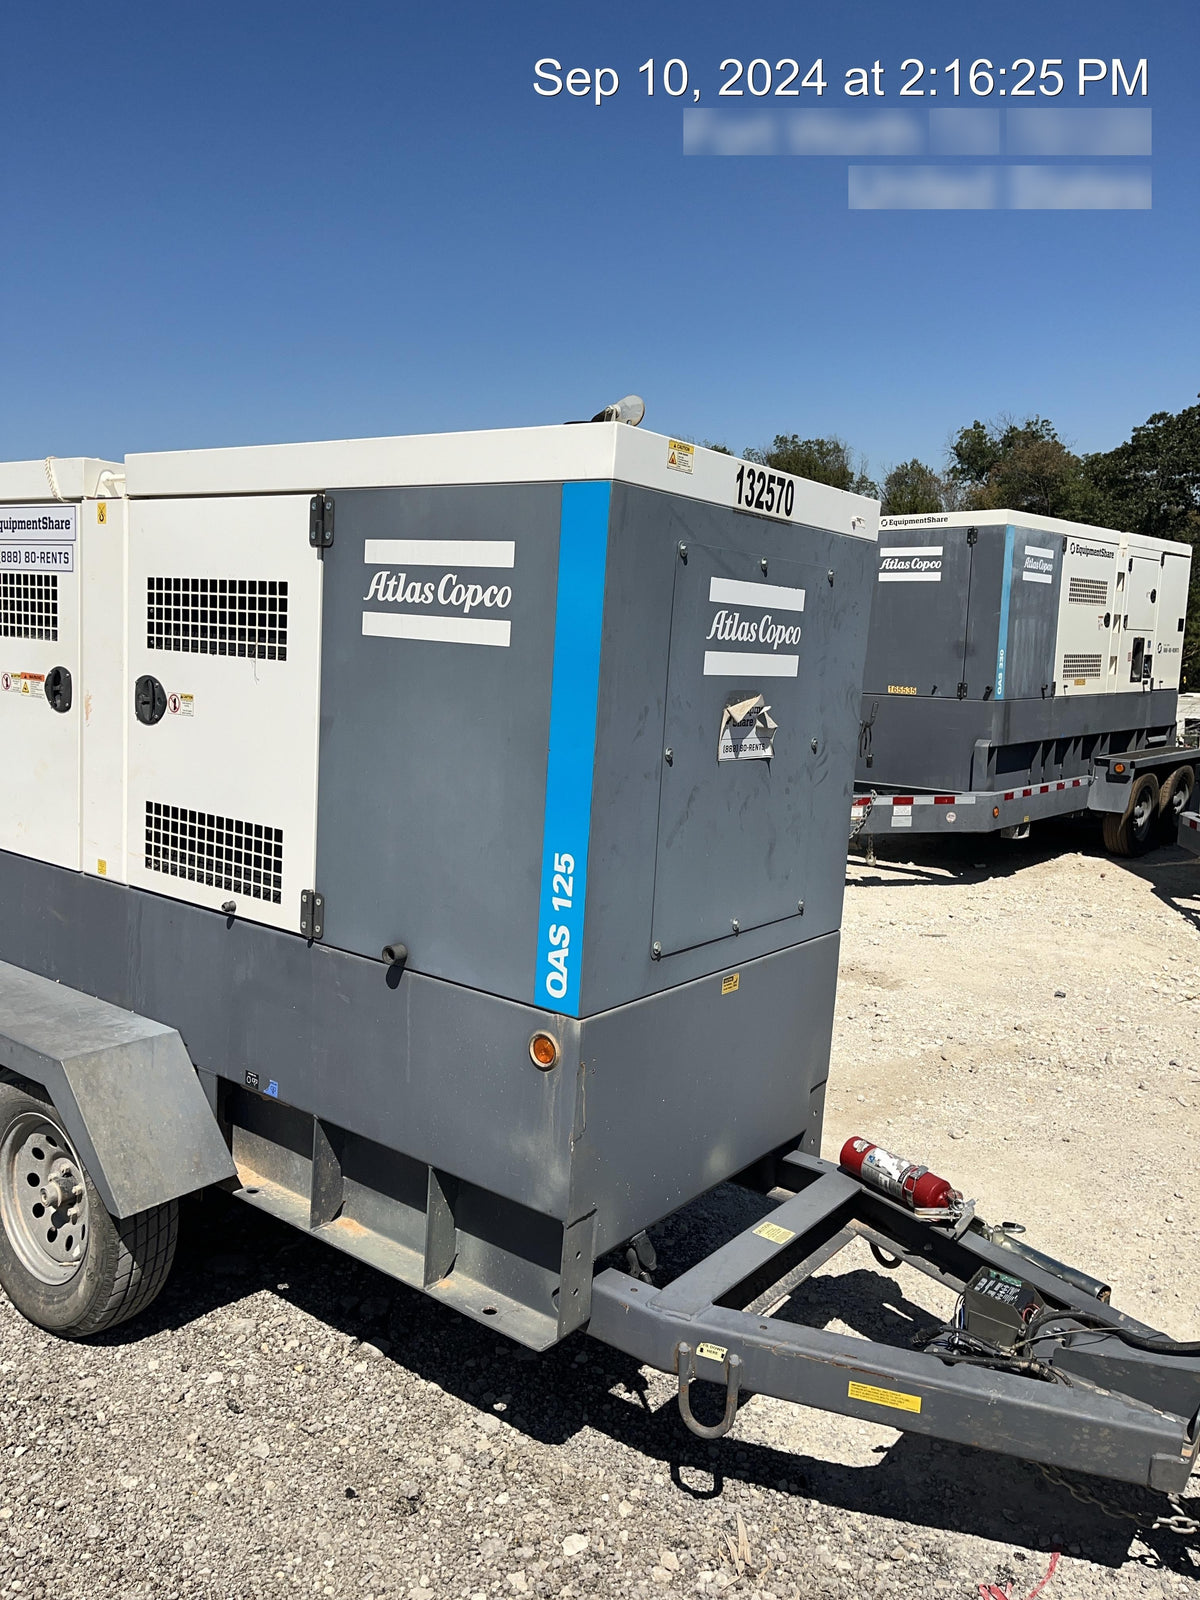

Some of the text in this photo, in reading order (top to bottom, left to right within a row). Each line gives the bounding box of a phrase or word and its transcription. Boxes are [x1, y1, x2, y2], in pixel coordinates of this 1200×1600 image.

[736, 464, 795, 517] 132570
[888, 516, 949, 527] EquipmentShare
[0, 550, 70, 565] 888) 80-RENTS
[1075, 543, 1115, 559] EquipmentShare
[879, 557, 942, 571] Atlas Copco
[1023, 556, 1054, 573] Atlas Copco
[363, 570, 513, 614] Atlas Copco
[706, 610, 802, 650] Atlas Copco
[545, 852, 575, 999] QAS 125
